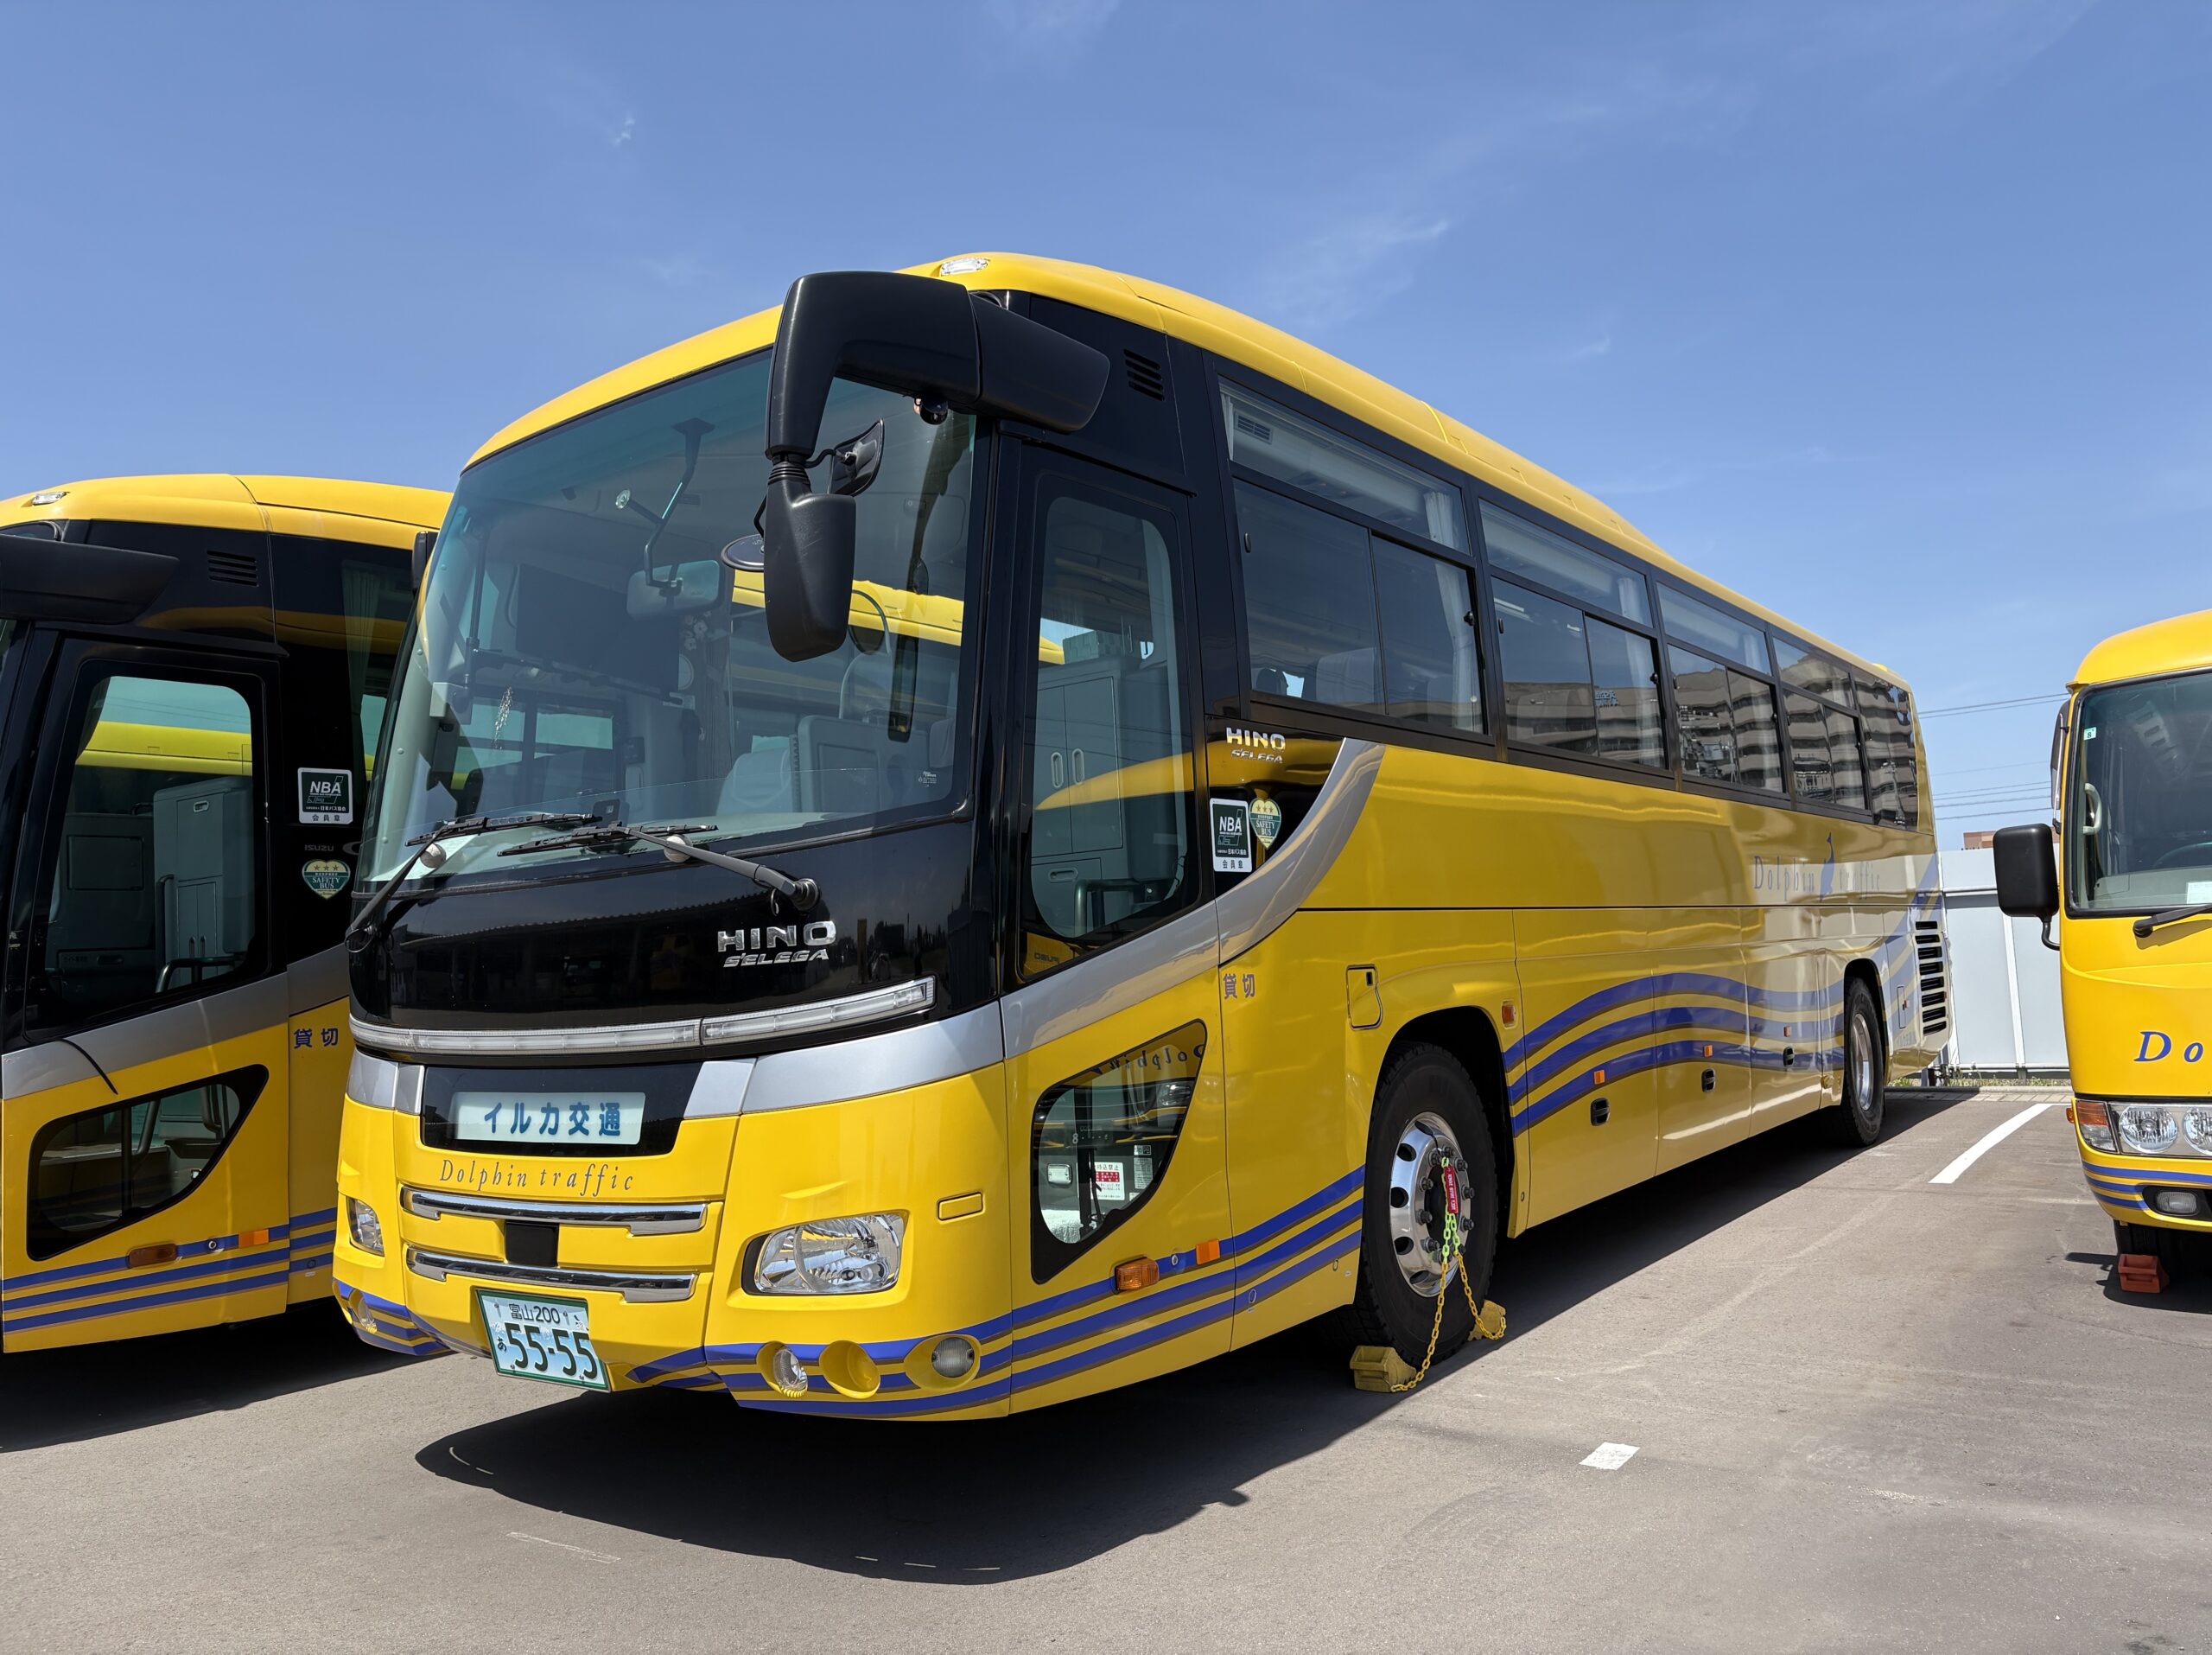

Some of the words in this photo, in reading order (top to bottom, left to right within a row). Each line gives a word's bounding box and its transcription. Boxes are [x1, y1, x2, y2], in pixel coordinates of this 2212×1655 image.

[1226, 727, 1286, 752] HINO
[310, 781, 341, 793] NBA
[1219, 816, 1243, 832] NBA
[1255, 819, 1275, 830] SAFETY
[1754, 856, 1815, 901] Dolphin
[1840, 861, 1879, 900] traffic
[717, 920, 836, 952] HINO
[1224, 973, 1255, 1000] 貸切
[294, 1028, 338, 1049] 貸切
[2133, 1031, 2204, 1063] Do
[484, 1102, 621, 1137] イルカ交通
[440, 1159, 528, 1192] Dolphin
[540, 1163, 634, 1198] traffic
[504, 1322, 598, 1379] 55-55
